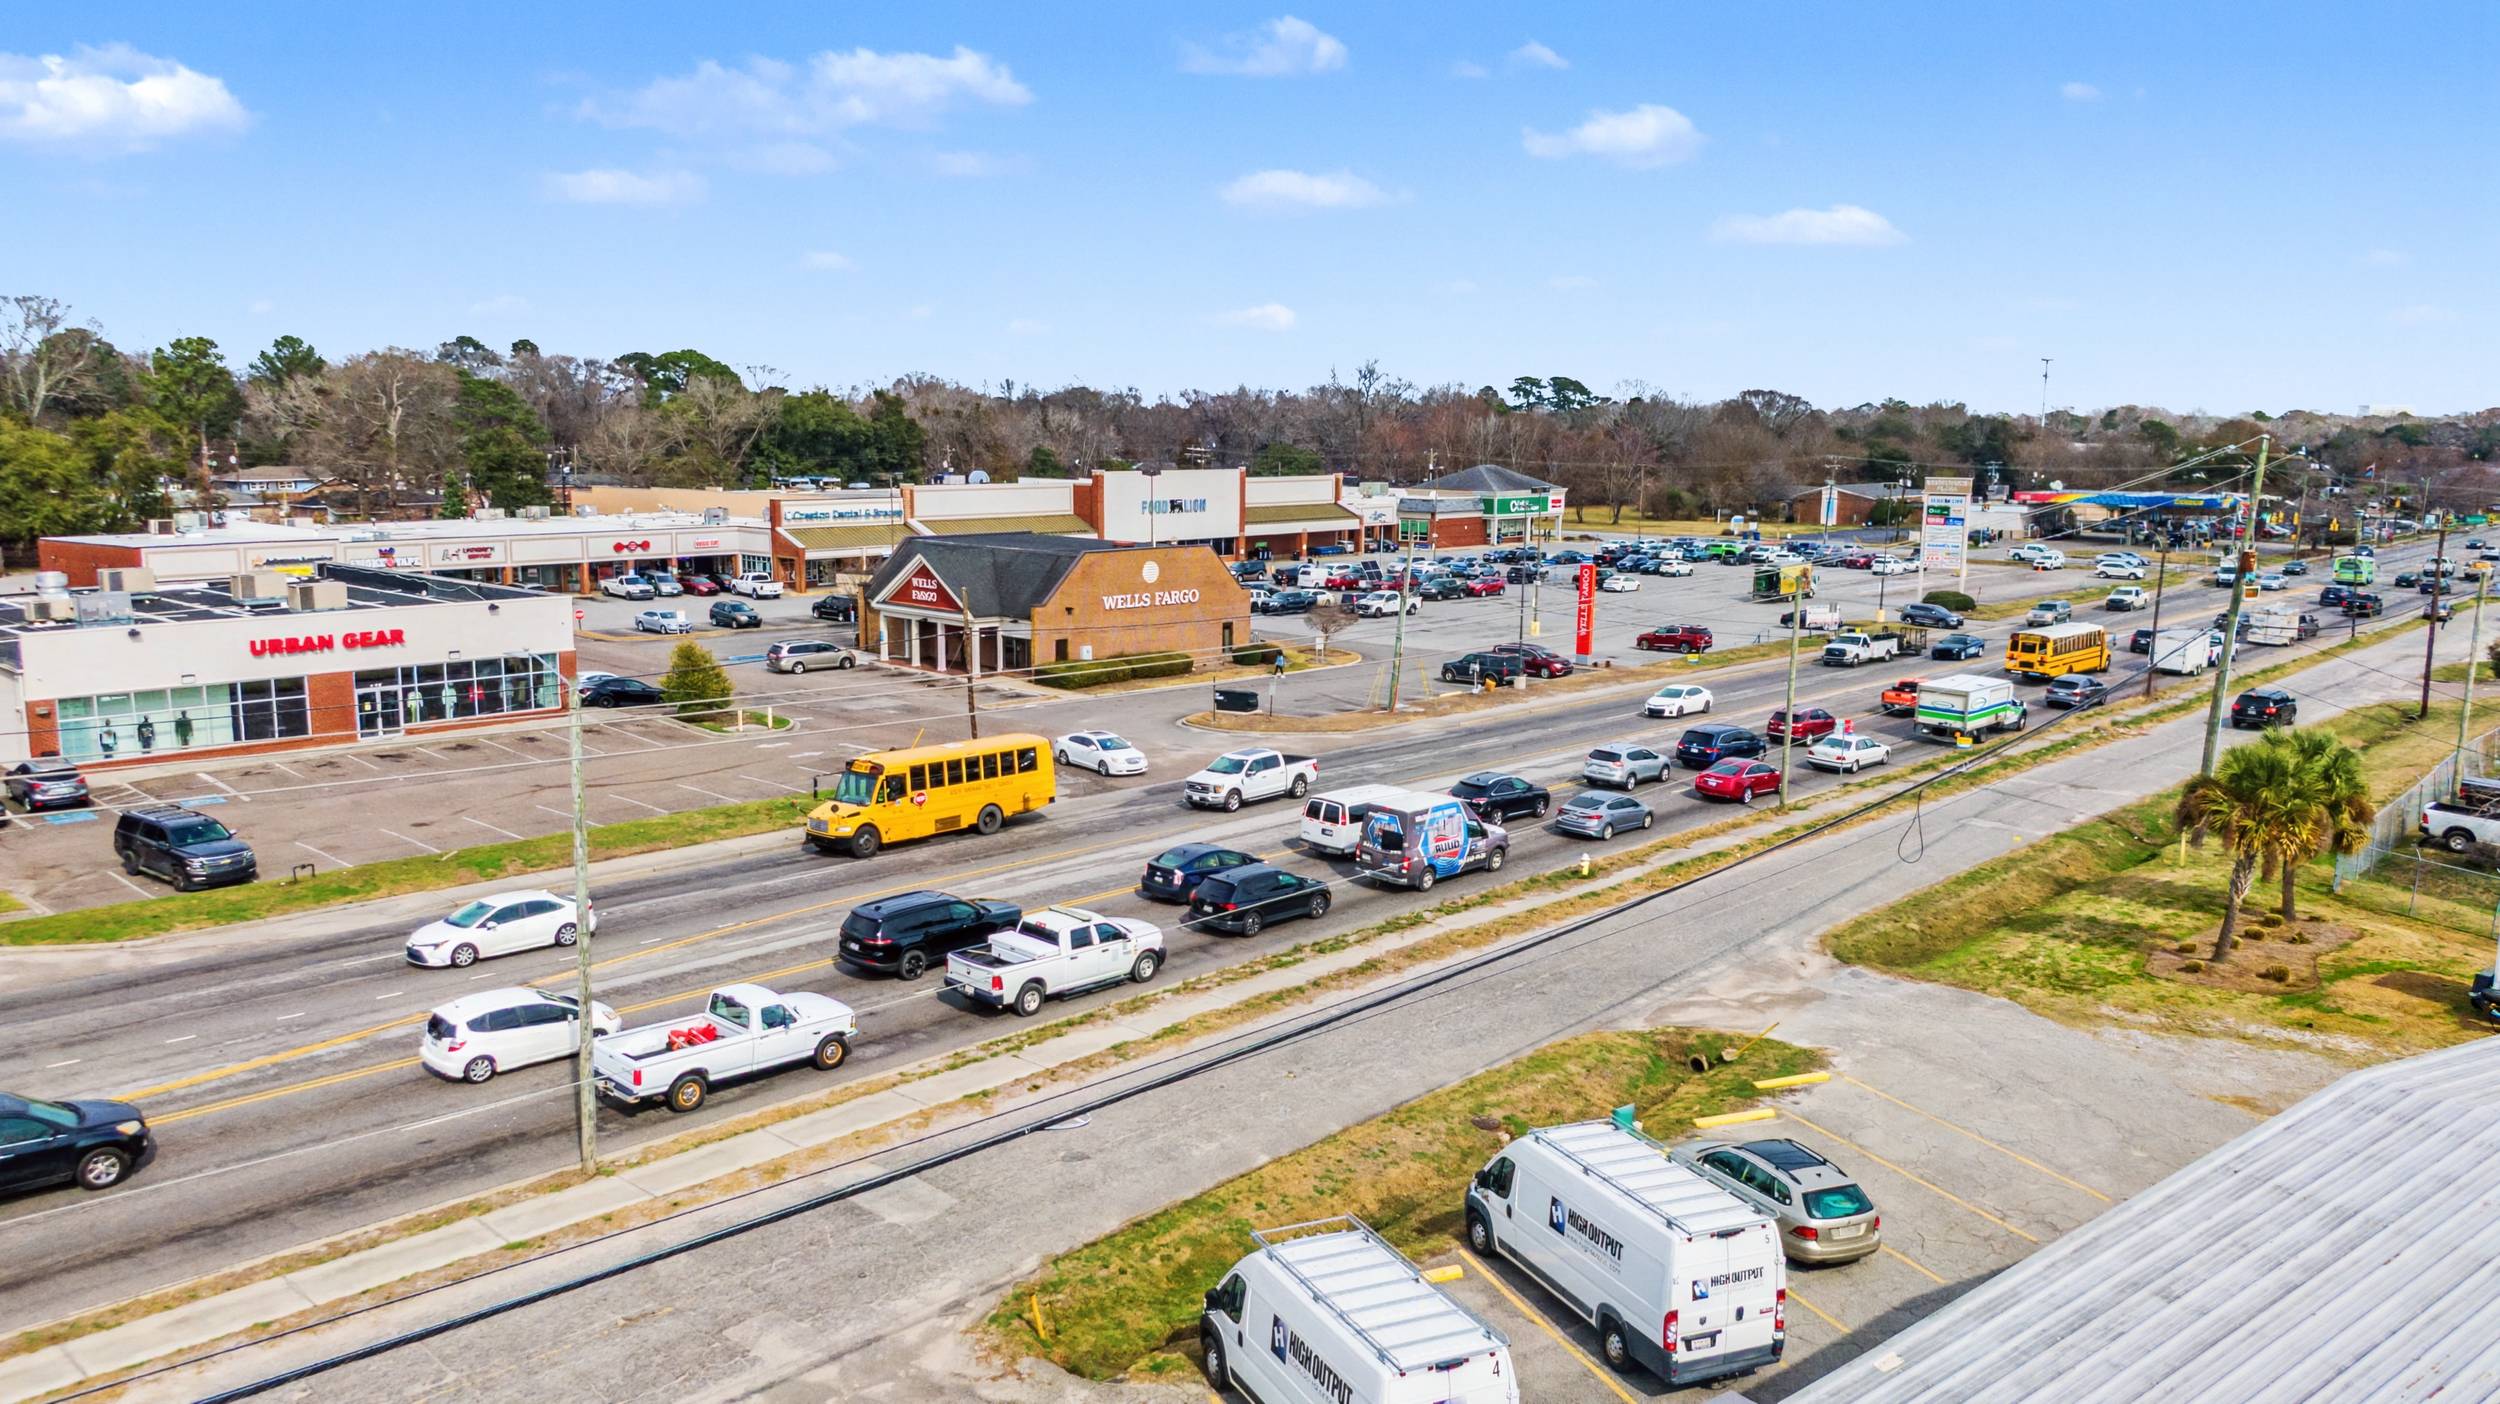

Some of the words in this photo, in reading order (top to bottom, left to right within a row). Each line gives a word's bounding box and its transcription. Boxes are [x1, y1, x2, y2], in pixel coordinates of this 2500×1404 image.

[1141, 500, 1168, 514] FOOD
[1184, 498, 1206, 513] LION
[912, 577, 937, 589] WELLS
[1103, 593, 1151, 610] WELLS
[1155, 589, 1200, 606] FARGO
[250, 634, 334, 656] URBAN
[342, 629, 405, 649] GEAR
[1568, 1208, 1588, 1236] HIGH
[1588, 1222, 1624, 1261] OUTPUT
[1711, 1273, 1730, 1287] HIGH
[1731, 1266, 1764, 1284] OUTPUT
[1289, 1330, 1313, 1373] HIGH
[1312, 1354, 1353, 1404] OUTPUT
[1493, 1360, 1500, 1377] 4
